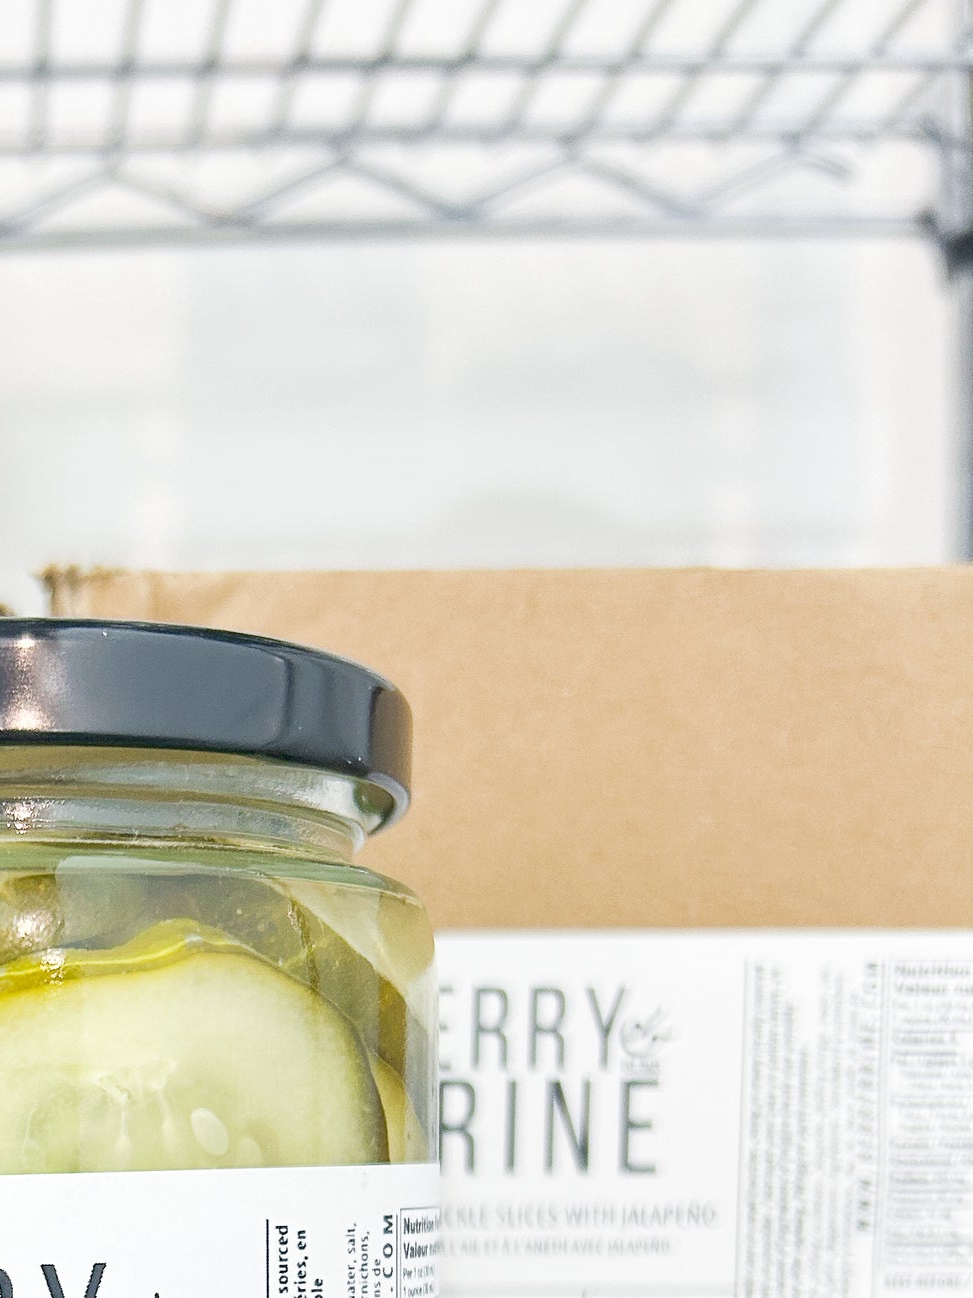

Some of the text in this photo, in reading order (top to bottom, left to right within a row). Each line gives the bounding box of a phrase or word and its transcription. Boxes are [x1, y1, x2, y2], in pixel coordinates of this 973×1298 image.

[439, 985, 627, 1071] ERRY
[439, 1078, 660, 1176] RINE
[297, 1230, 306, 1250] en
[564, 1203, 615, 1228] WITH
[275, 1225, 289, 1293] sourced
